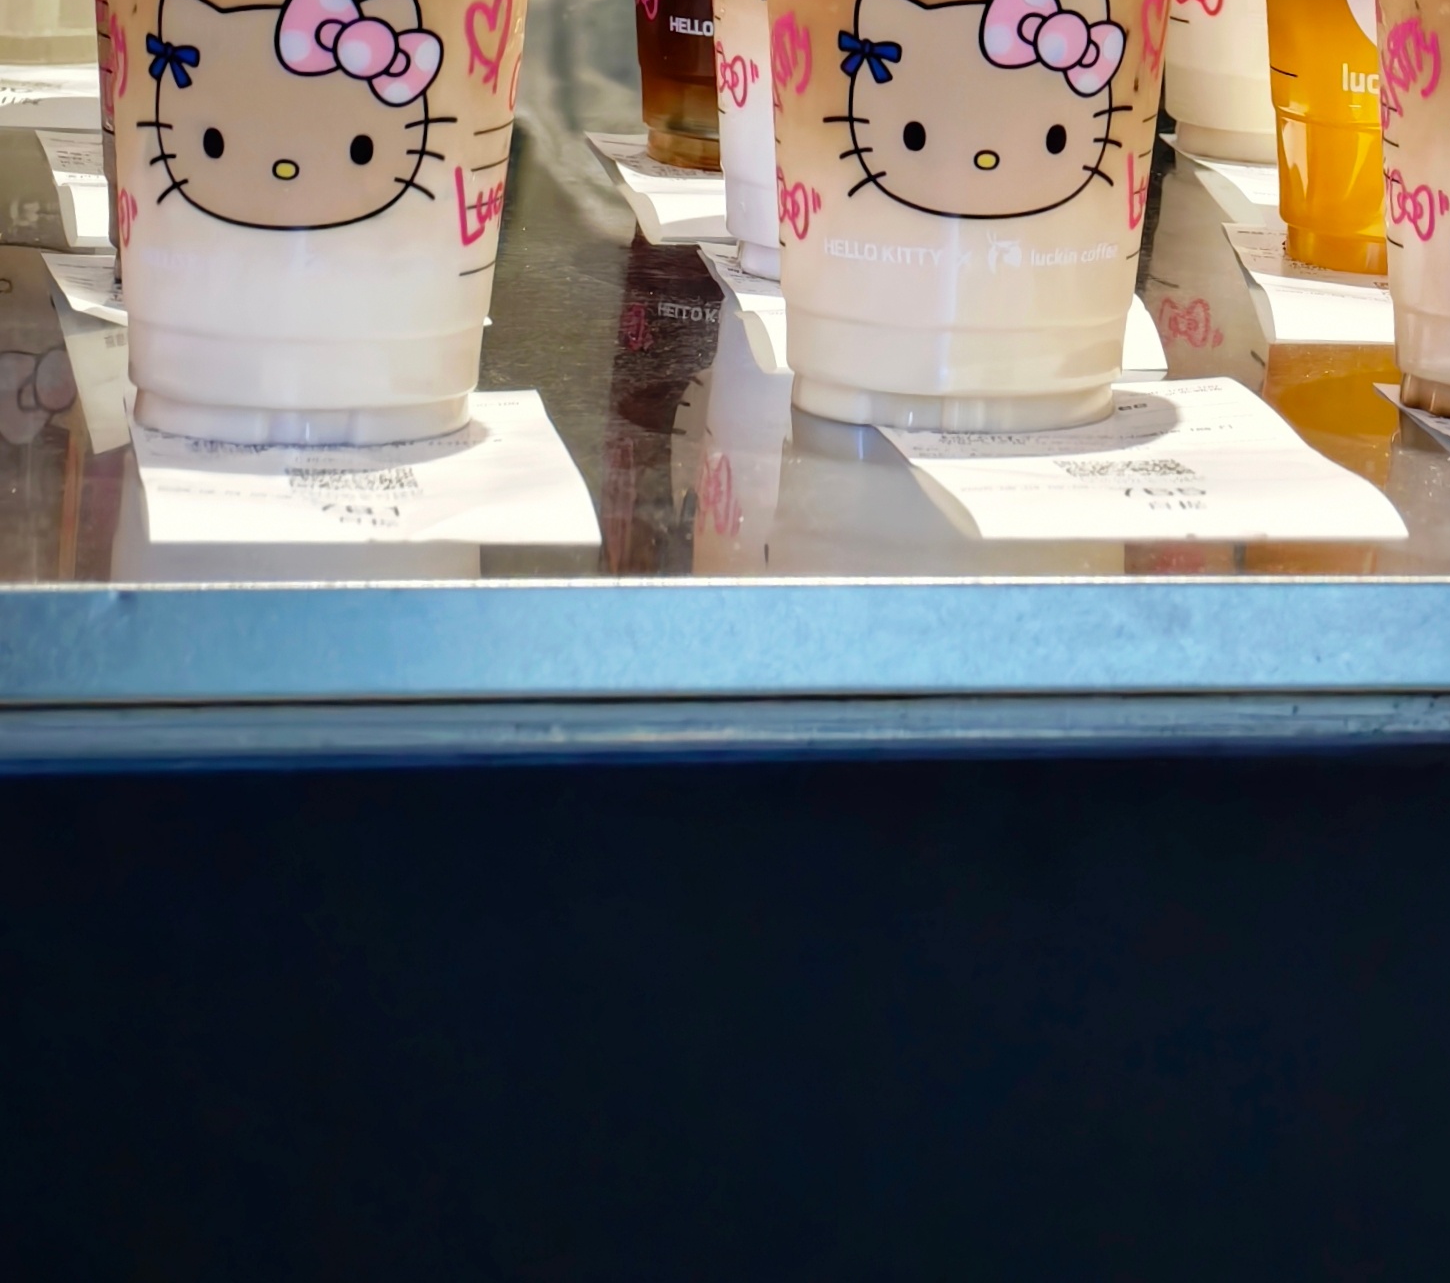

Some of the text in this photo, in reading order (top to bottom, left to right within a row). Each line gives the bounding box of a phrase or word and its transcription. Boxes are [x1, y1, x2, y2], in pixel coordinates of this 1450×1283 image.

[669, 15, 714, 36] HELLO
[824, 237, 878, 263] HELLO
[882, 245, 944, 267] KITTY
[1030, 247, 1078, 267] luckin
